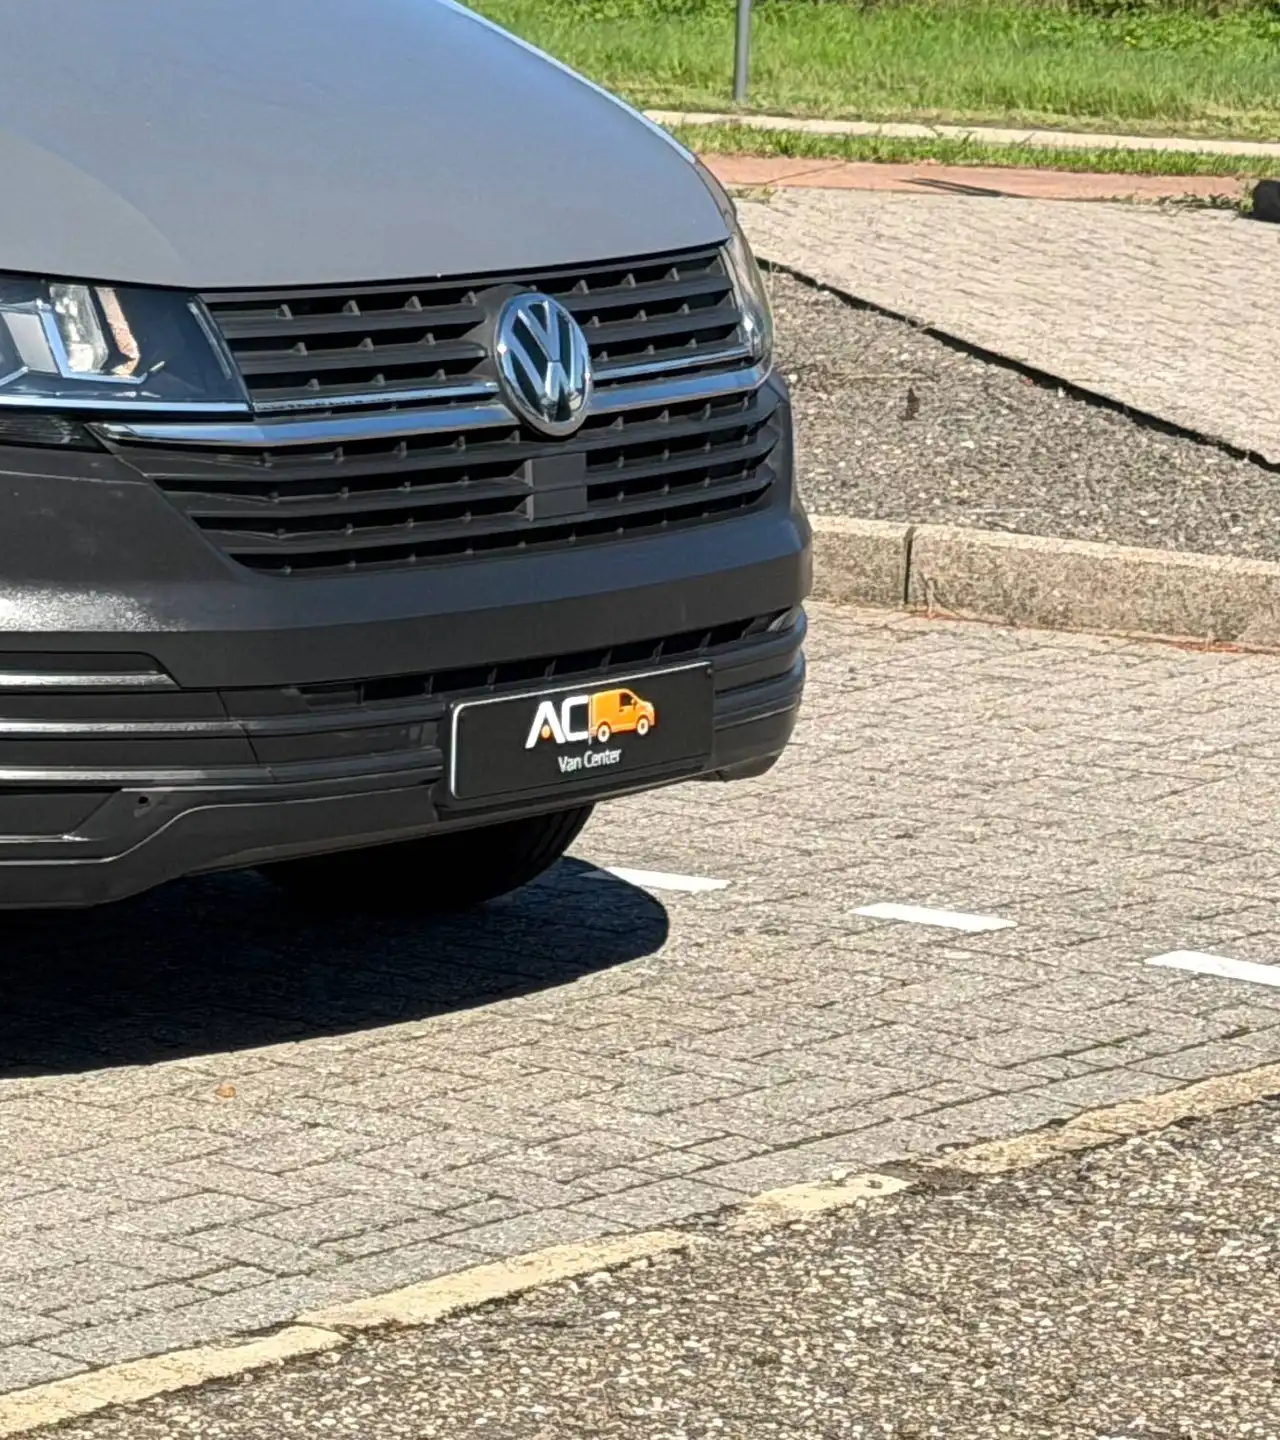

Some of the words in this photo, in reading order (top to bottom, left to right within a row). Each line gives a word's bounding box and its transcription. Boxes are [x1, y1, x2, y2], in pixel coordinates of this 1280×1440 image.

[525, 695, 589, 749] AC
[558, 755, 582, 773] Van
[584, 749, 622, 768] Center
